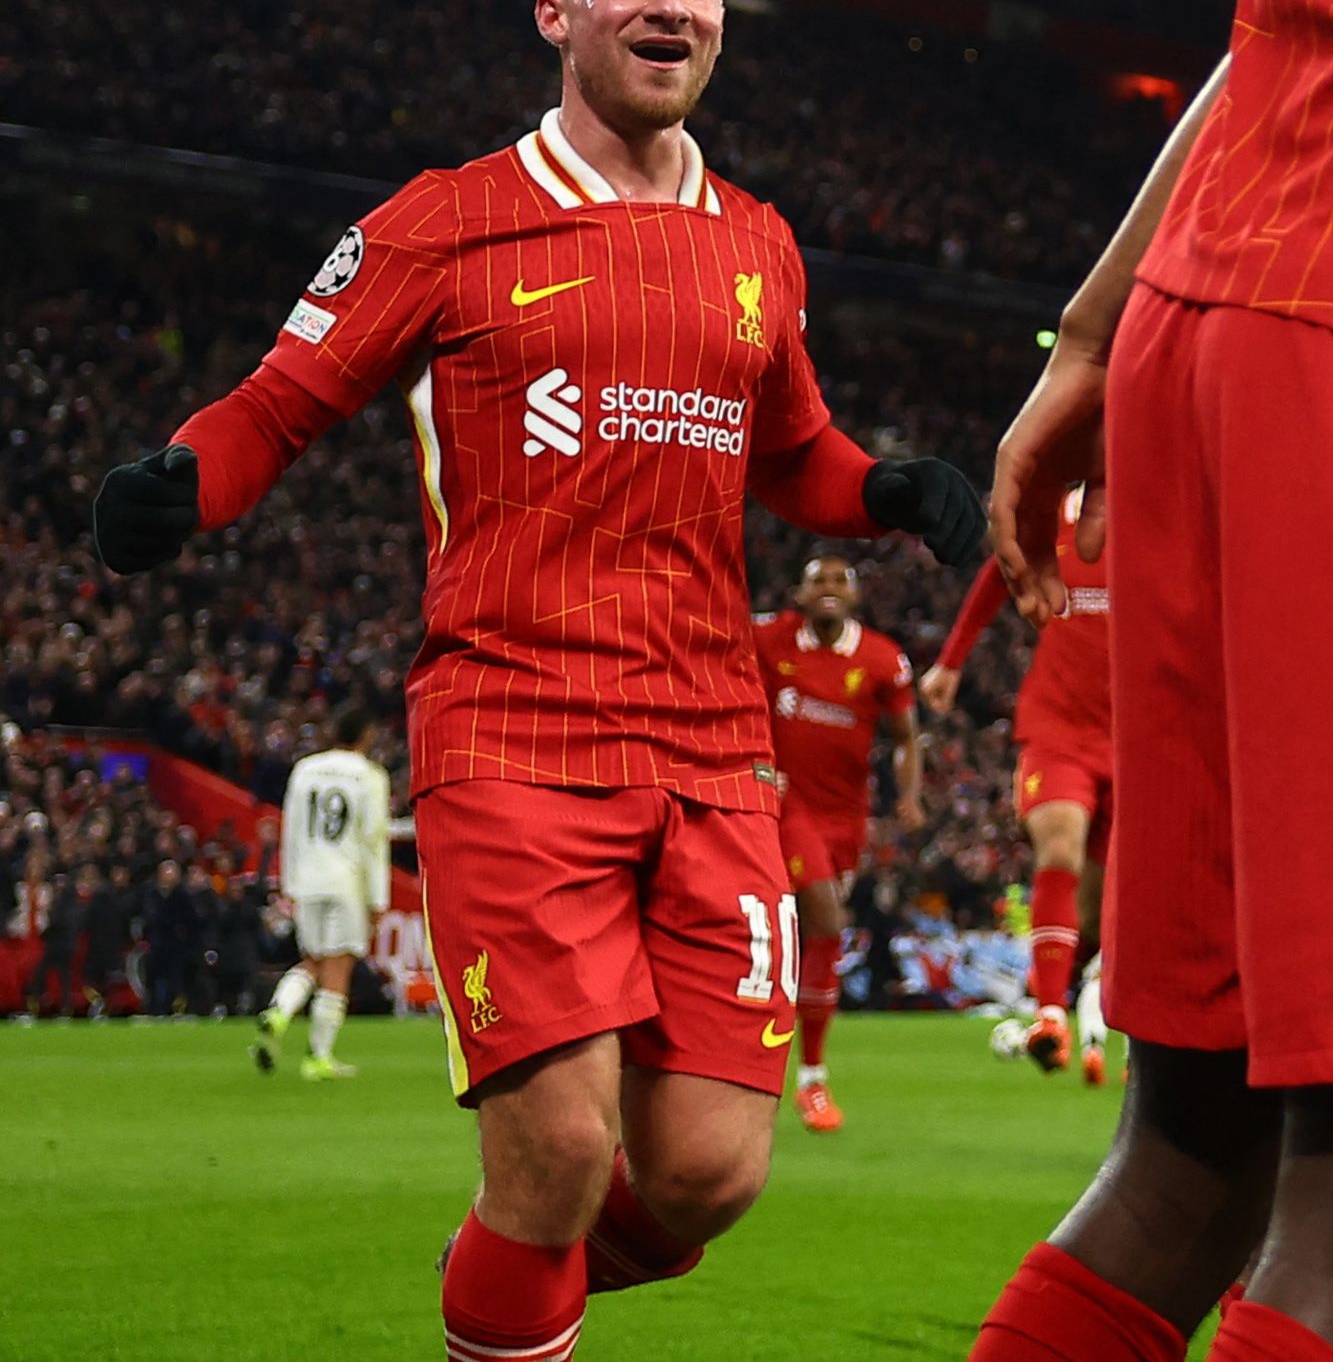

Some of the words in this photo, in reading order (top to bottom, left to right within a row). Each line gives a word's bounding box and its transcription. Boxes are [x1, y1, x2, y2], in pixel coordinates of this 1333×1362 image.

[600, 381, 748, 426] standard
[598, 411, 745, 456] chartered
[308, 786, 350, 842] 19
